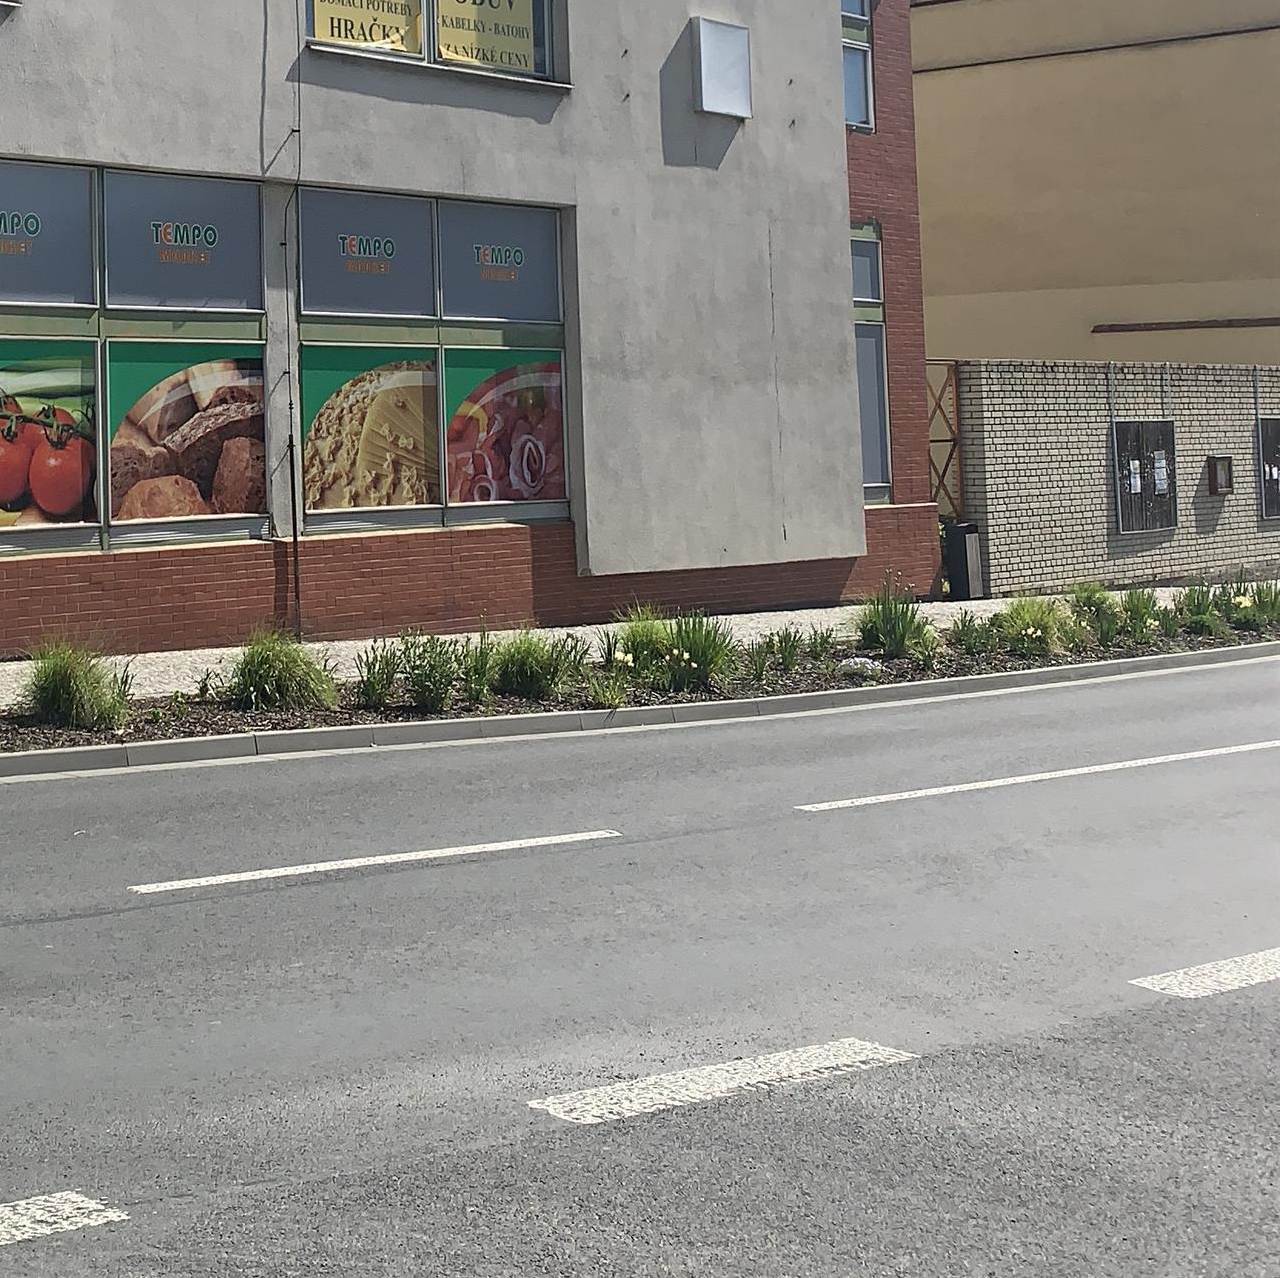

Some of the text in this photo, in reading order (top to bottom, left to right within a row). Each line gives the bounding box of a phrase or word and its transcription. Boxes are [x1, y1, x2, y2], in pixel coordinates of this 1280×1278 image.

[441, 15, 487, 33] KABELKY
[494, 22, 531, 39] BATOHY
[500, 51, 530, 68] CENY
[151, 222, 218, 248] TEMPO
[338, 234, 396, 259] TEMPO
[473, 244, 525, 267] TEMPO
